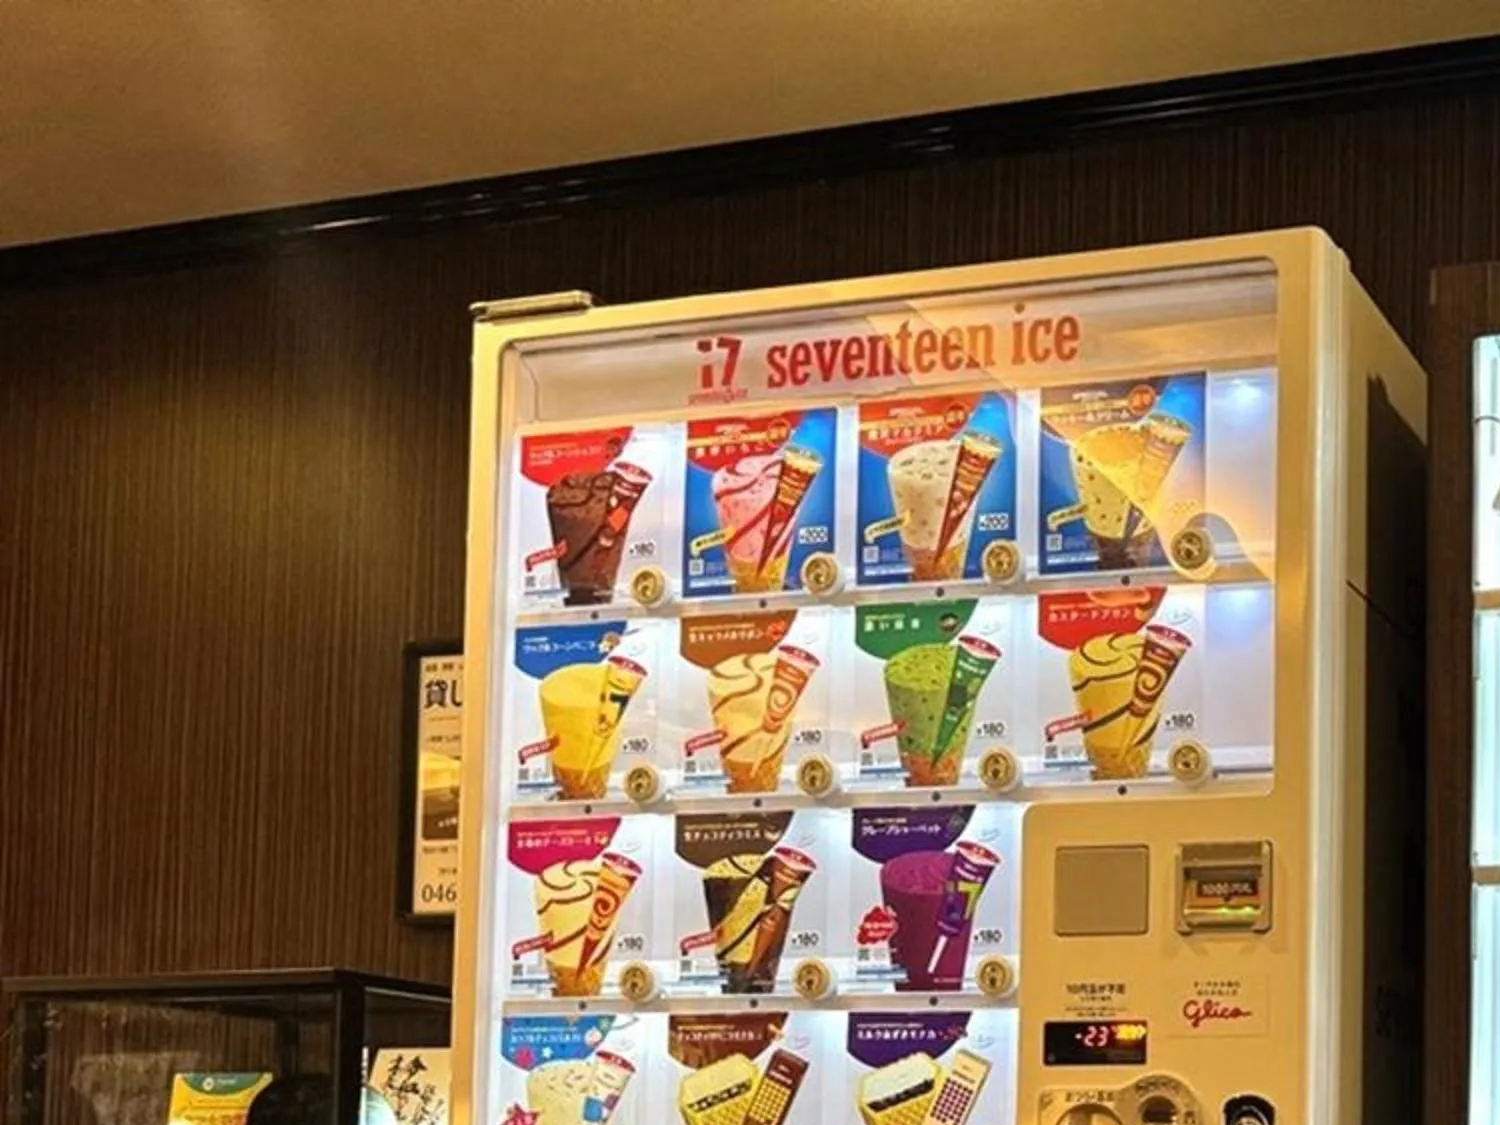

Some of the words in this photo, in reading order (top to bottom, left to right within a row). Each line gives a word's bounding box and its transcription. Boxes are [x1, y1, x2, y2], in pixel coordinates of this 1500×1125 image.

[766, 320, 997, 390] seventeen
[1010, 303, 1081, 363] ice
[420, 883, 458, 904] 046
